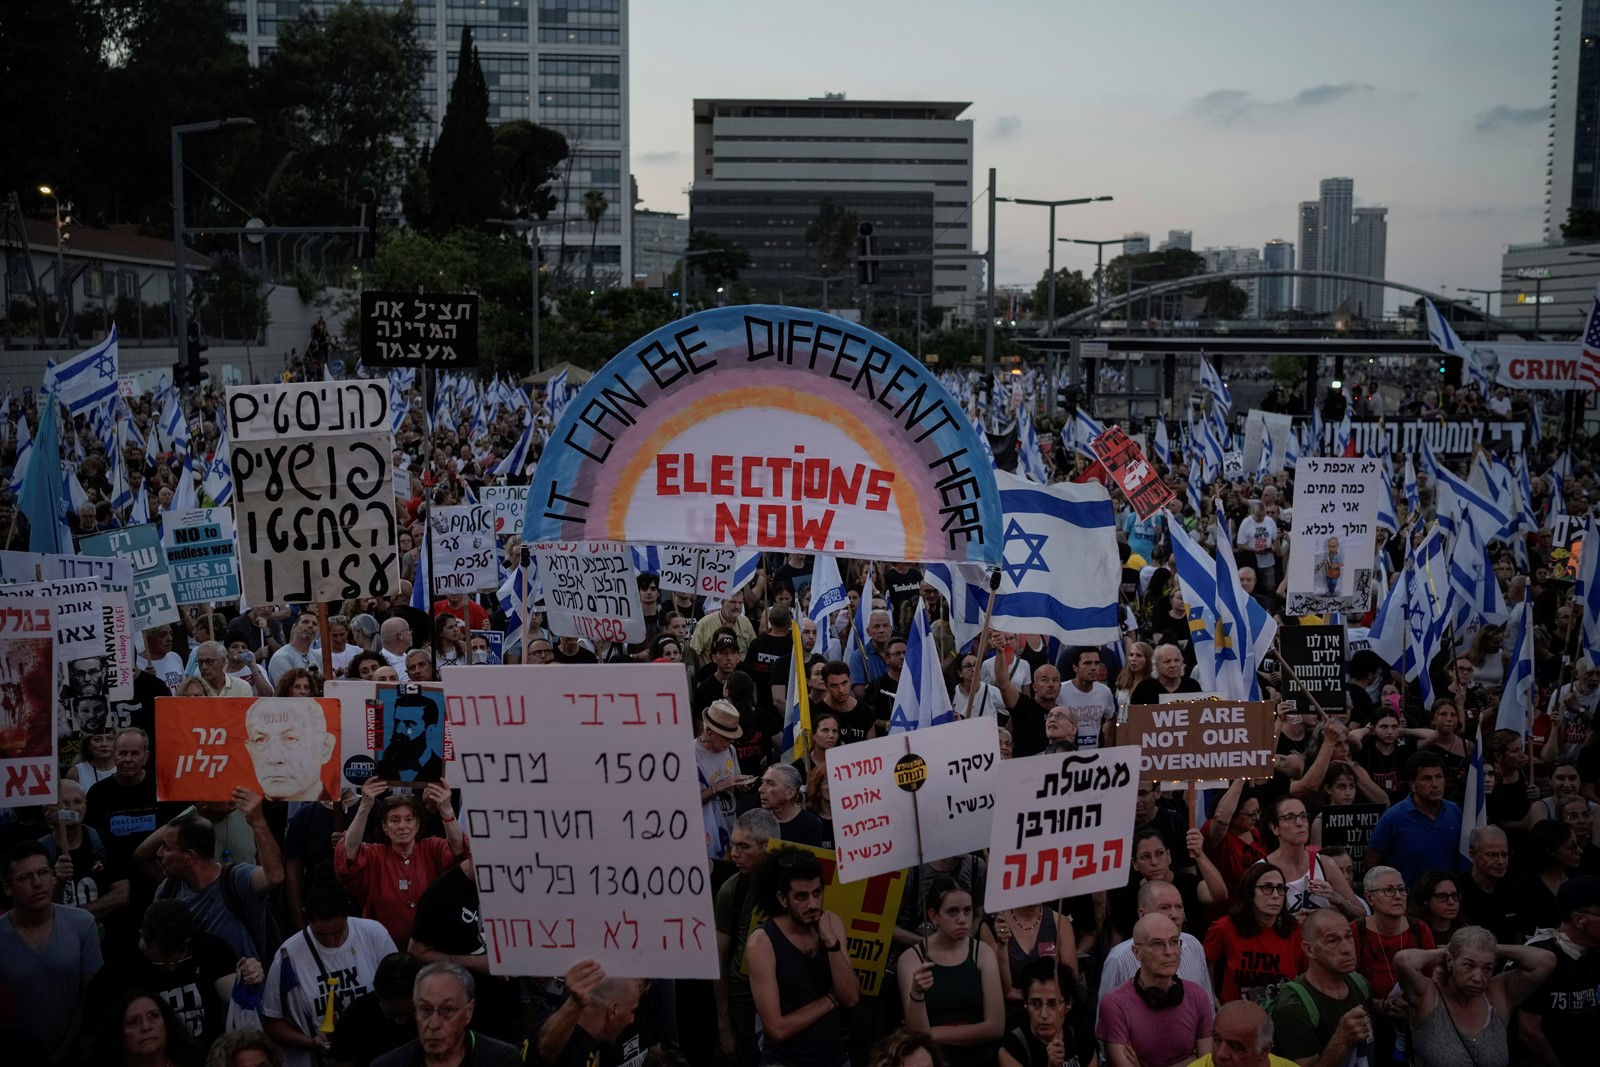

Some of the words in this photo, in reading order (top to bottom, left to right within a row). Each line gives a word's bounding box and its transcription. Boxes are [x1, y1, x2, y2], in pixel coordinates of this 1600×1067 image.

[370, 300, 405, 318] את
[414, 299, 473, 320] תציל
[376, 320, 457, 339] המדינה
[636, 325, 718, 389] BE
[744, 315, 961, 443] DIFFERENT
[1508, 358, 1578, 380] CRIM
[564, 373, 644, 464] CAN
[1488, 421, 1526, 452] די
[231, 442, 386, 502] פושעים
[1308, 461, 1319, 472] לי
[1323, 463, 1354, 473] אכפת
[1361, 461, 1376, 473] לא
[929, 447, 984, 551] HERE
[1303, 484, 1336, 494] מתים.
[1341, 484, 1365, 493] כמה
[543, 480, 590, 524] IT
[1320, 501, 1335, 513] לא
[1342, 502, 1359, 512] אני
[175, 527, 200, 544] NO
[204, 527, 218, 538] to
[714, 502, 845, 551] NOW.
[1302, 523, 1335, 535] לכלא.
[1342, 522, 1367, 536] הולך
[167, 547, 209, 561] endless
[211, 543, 233, 555] war
[440, 535, 460, 552] עד
[582, 556, 629, 573] במבצע
[667, 553, 692, 567] את
[176, 562, 210, 580] YES
[214, 563, 227, 574] to
[264, 553, 397, 602] עלינו
[553, 570, 585, 590] אלפי
[177, 583, 185, 592] a
[185, 575, 227, 591] regional
[435, 572, 475, 594] האחרון
[592, 572, 627, 595] חולצו
[702, 575, 727, 593] אש
[181, 587, 227, 601] alliance
[58, 601, 93, 615] אותנ
[587, 595, 631, 617] חרדים
[102, 605, 118, 688] NETANYAHU
[1306, 634, 1321, 648] לנו
[1323, 635, 1340, 649] אין
[1312, 649, 1341, 662] ילדים
[1293, 663, 1341, 677] למלחמות
[1324, 678, 1342, 692] בלי
[445, 695, 526, 726] ערום
[1152, 709, 1189, 728] WE
[1199, 707, 1245, 724] ARE
[192, 727, 228, 746] מר
[1142, 731, 1188, 749] NOT
[1203, 728, 1249, 745] OUR
[175, 749, 229, 779] קלון
[461, 752, 548, 783] מתים
[595, 752, 680, 784] 1500
[948, 752, 994, 783] עסקה
[1140, 750, 1271, 771] OVERNMENT
[5, 763, 51, 797] צא
[1036, 753, 1130, 798] ממשלת
[841, 788, 882, 810] אותם
[622, 810, 688, 840] 120
[842, 815, 890, 837] הביתה
[1016, 803, 1102, 849] החורבן
[1326, 813, 1354, 829] אמא,
[1346, 827, 1362, 842] לנו
[475, 852, 575, 894] פליטים
[1003, 838, 1123, 890] הביתה
[589, 865, 704, 899] 130,000
[603, 910, 639, 950] לא
[664, 917, 706, 950] זה
[484, 918, 576, 964] נצחון
[1241, 951, 1280, 972] אתה
[1550, 991, 1567, 1010] 75
